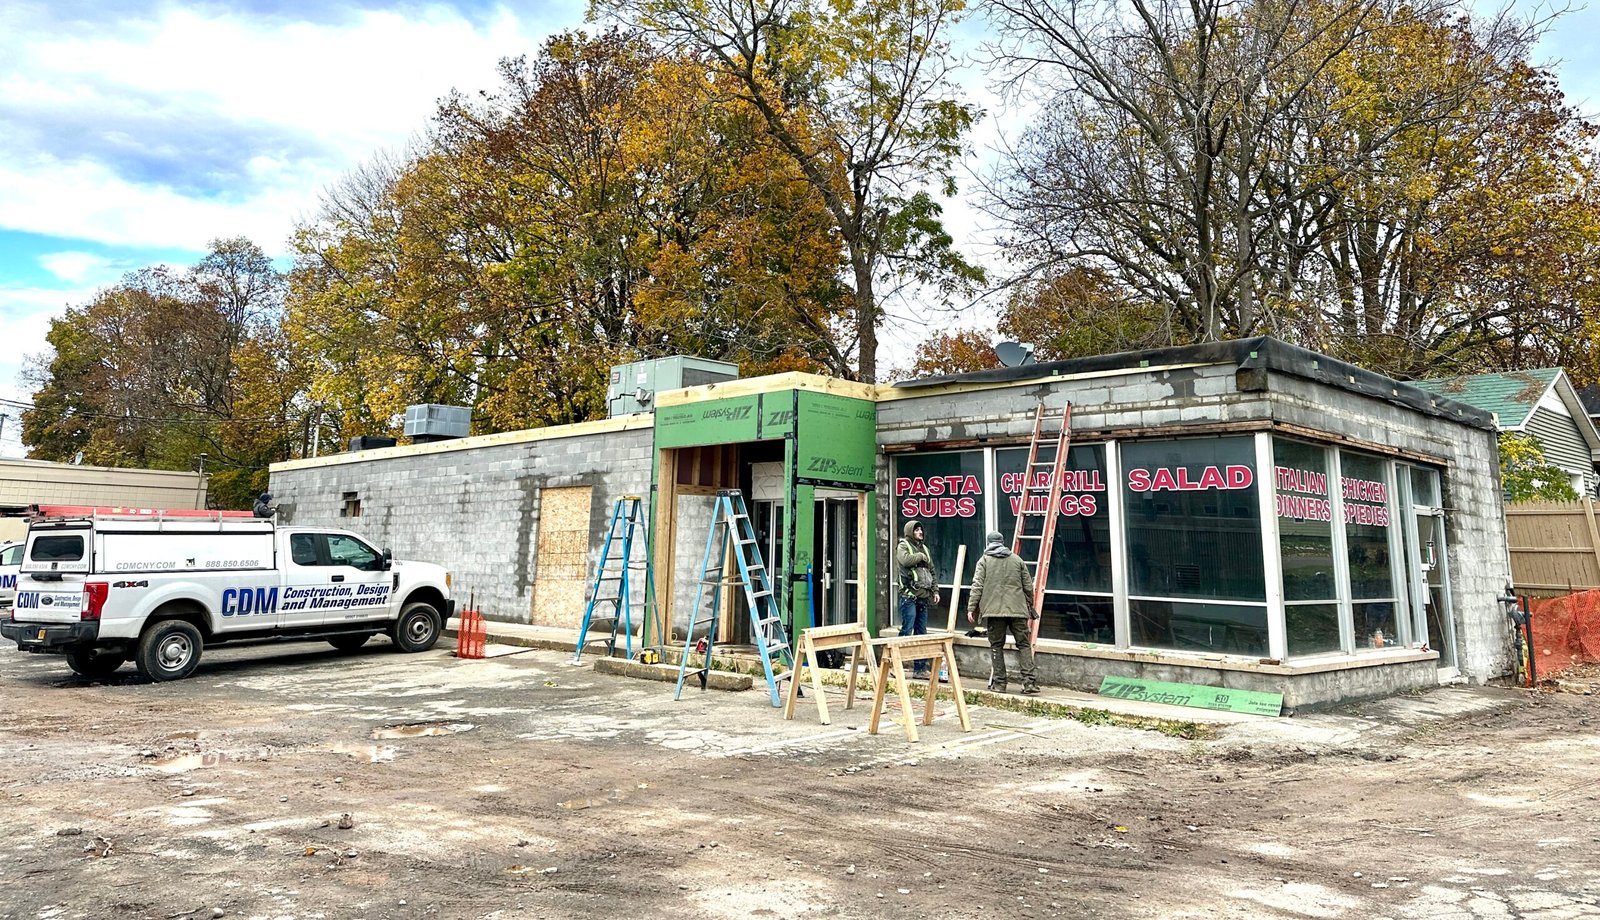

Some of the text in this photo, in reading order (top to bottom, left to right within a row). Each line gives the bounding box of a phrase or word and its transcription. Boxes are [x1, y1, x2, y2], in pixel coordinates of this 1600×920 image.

[896, 475, 983, 497] PASTA
[1001, 470, 1106, 493] CHRRILL
[1129, 465, 1253, 492] SALAD
[1275, 466, 1328, 496] ITALIAN
[1340, 476, 1388, 504] CHICKEN
[902, 498, 976, 518] SUBS
[1275, 494, 1333, 522] DINNERS
[1343, 502, 1391, 528] SPIEDIES
[116, 561, 177, 570] CDMCNY.COM
[205, 560, 260, 568] 888.850.6506
[0, 575, 16, 588] M
[284, 583, 390, 599] Construction, Design
[17, 592, 40, 609] CDM
[221, 587, 279, 617] CDM
[281, 594, 388, 611] and Management
[1099, 682, 1192, 705] ZIPsystem
